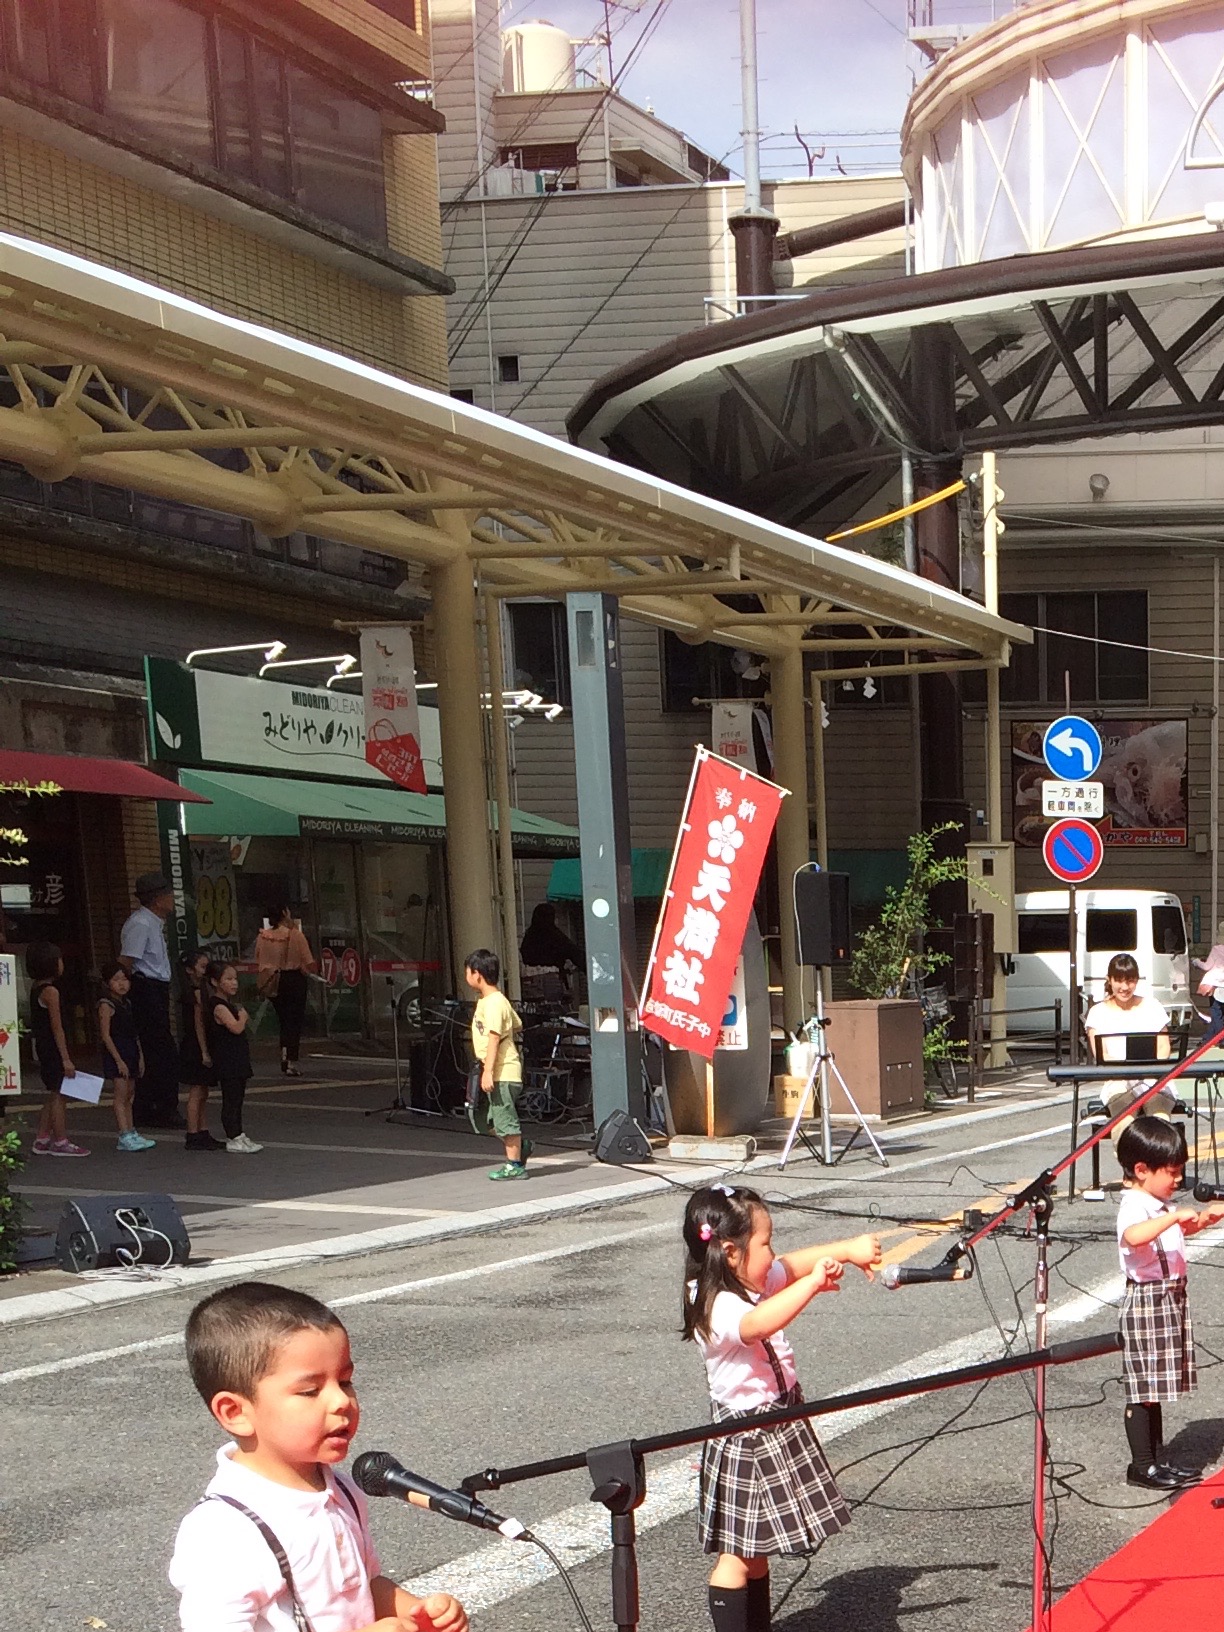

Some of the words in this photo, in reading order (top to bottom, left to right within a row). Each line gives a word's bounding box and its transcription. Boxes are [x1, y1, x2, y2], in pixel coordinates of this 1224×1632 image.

[262, 710, 318, 746] みどりや
[336, 722, 366, 750] クリ
[1047, 786, 1099, 799] 一方通行
[301, 819, 342, 836] MIDORIYA
[344, 821, 384, 837] CLEANING
[661, 858, 733, 1006] 天満社
